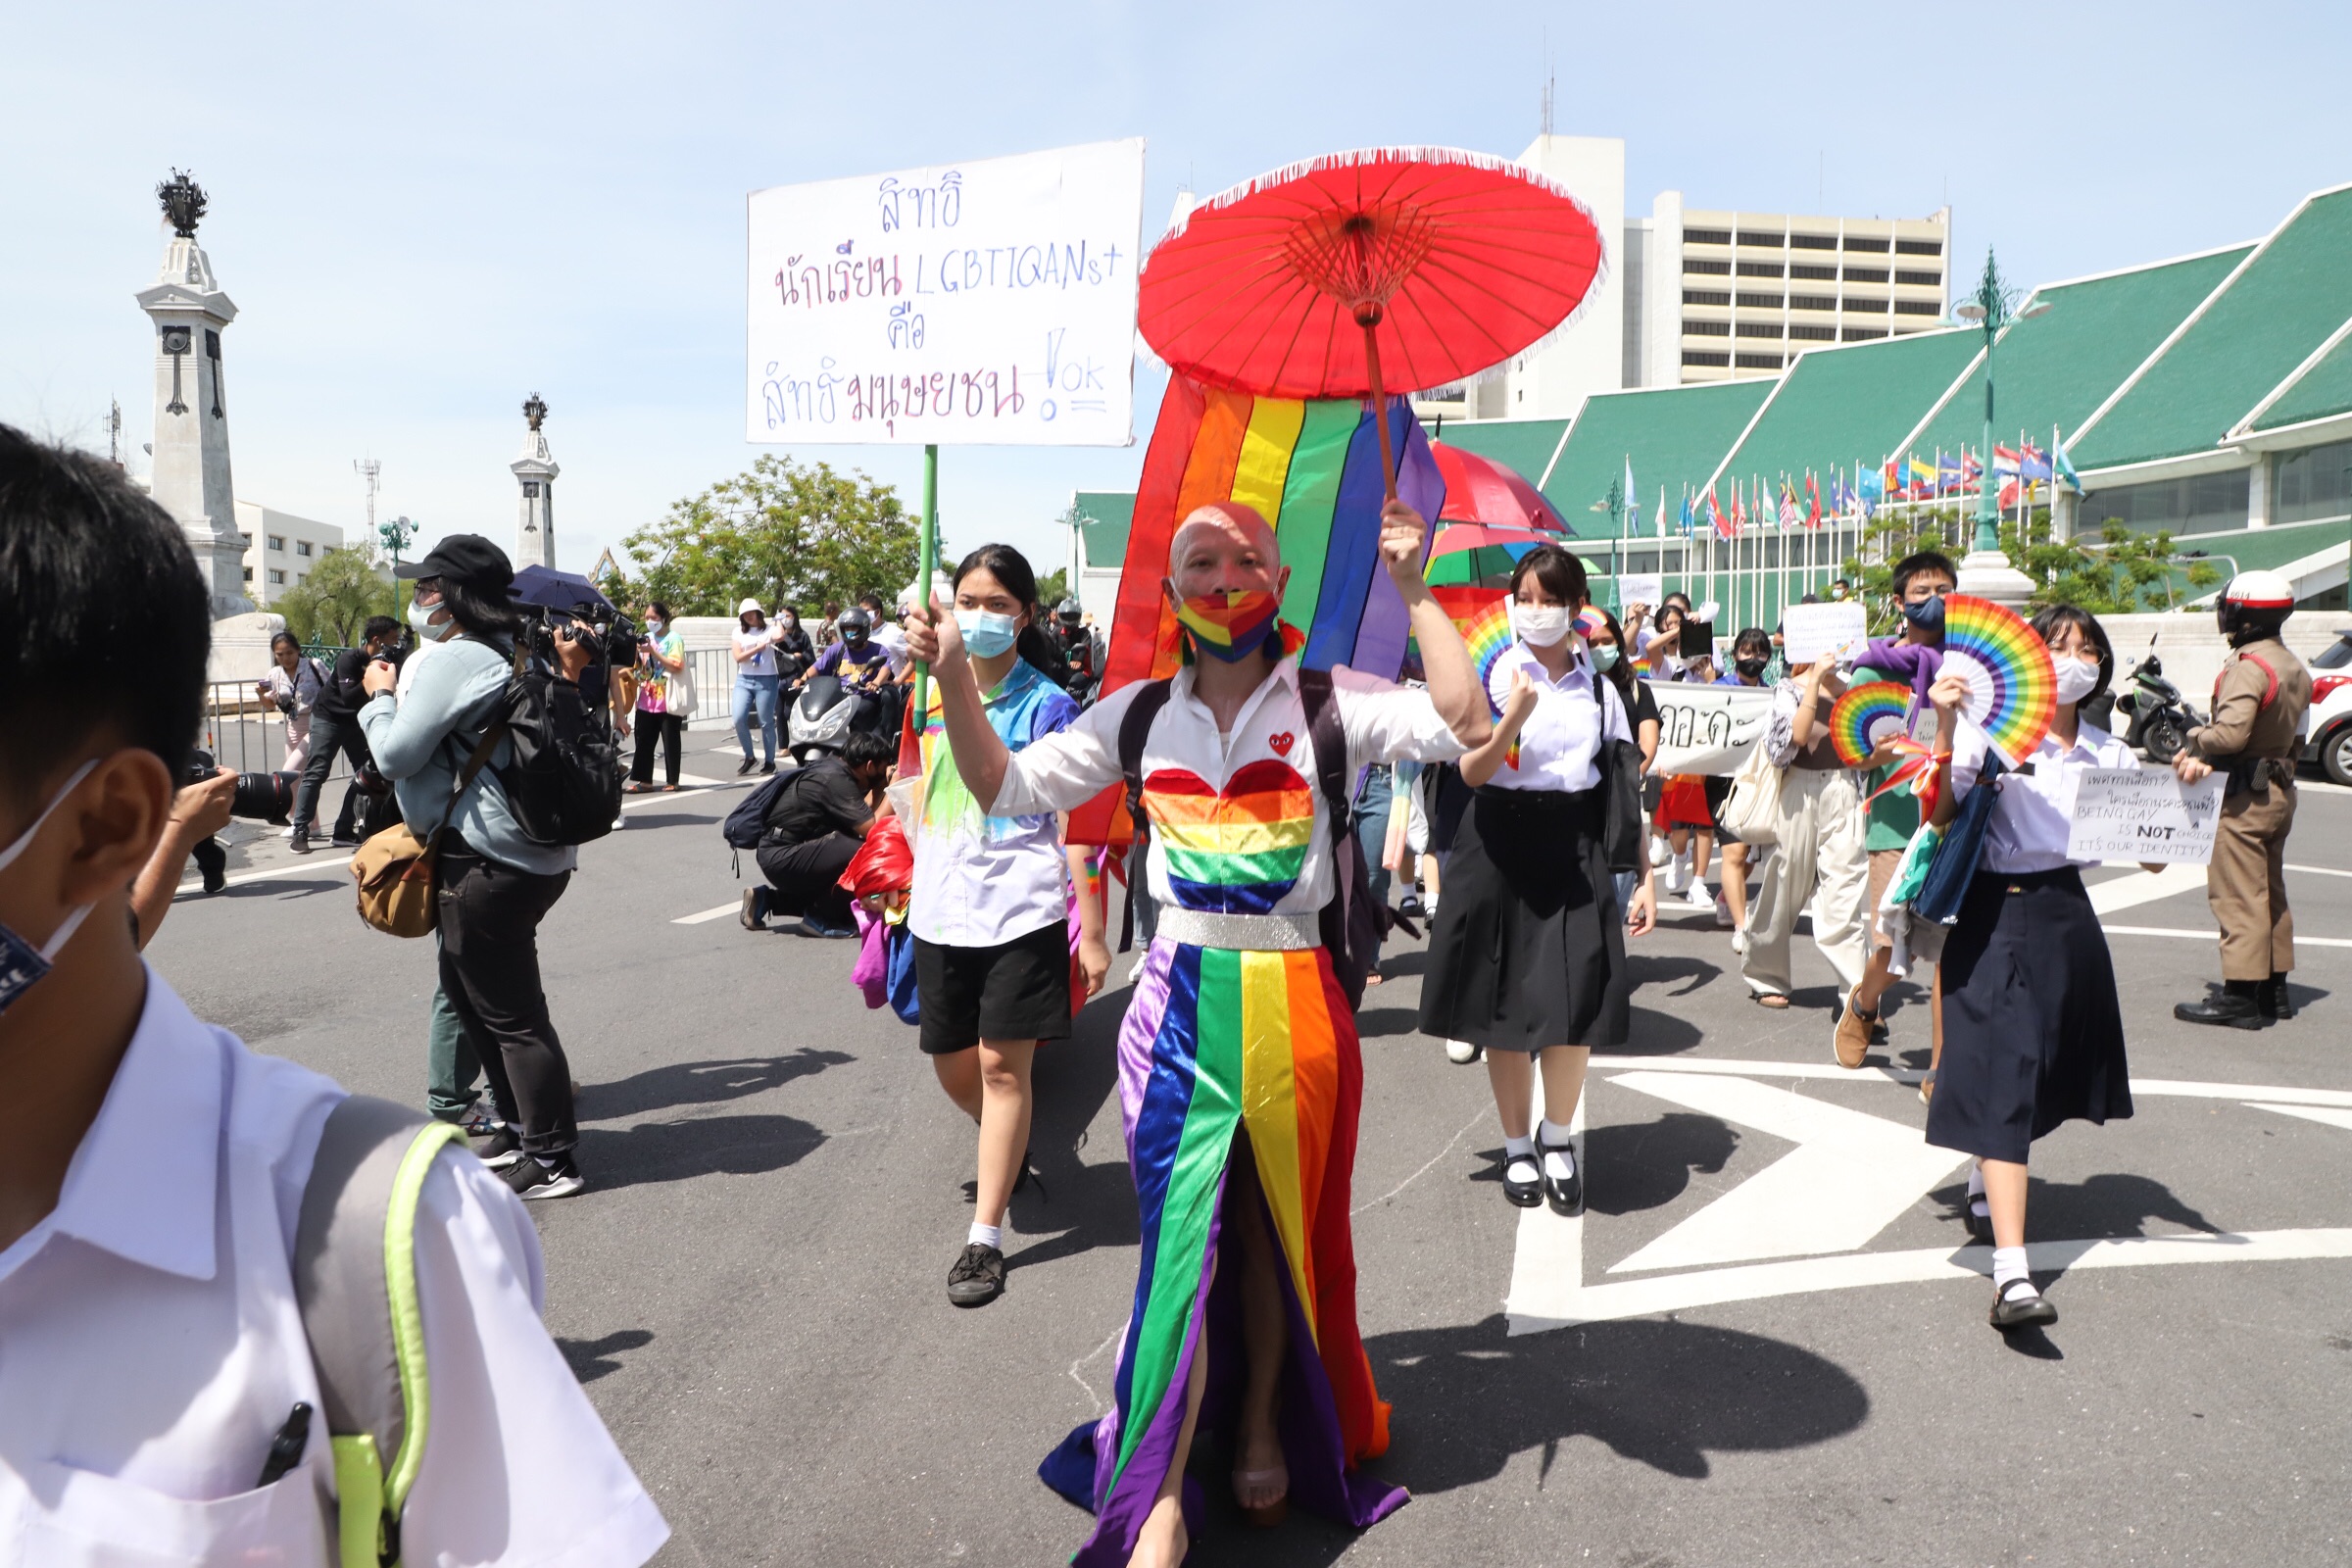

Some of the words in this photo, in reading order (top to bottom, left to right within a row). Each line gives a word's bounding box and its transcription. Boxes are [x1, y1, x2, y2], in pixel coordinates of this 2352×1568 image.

[775, 238, 903, 309] นักเรียน
[888, 300, 925, 350] คือ
[2078, 805, 2123, 820] BEING
[2127, 806, 2158, 822] GAY
[2118, 823, 2132, 836] IS
[2136, 824, 2177, 841] NOT
[2107, 841, 2133, 852] OUR
[2138, 842, 2210, 858] IDENTITY
